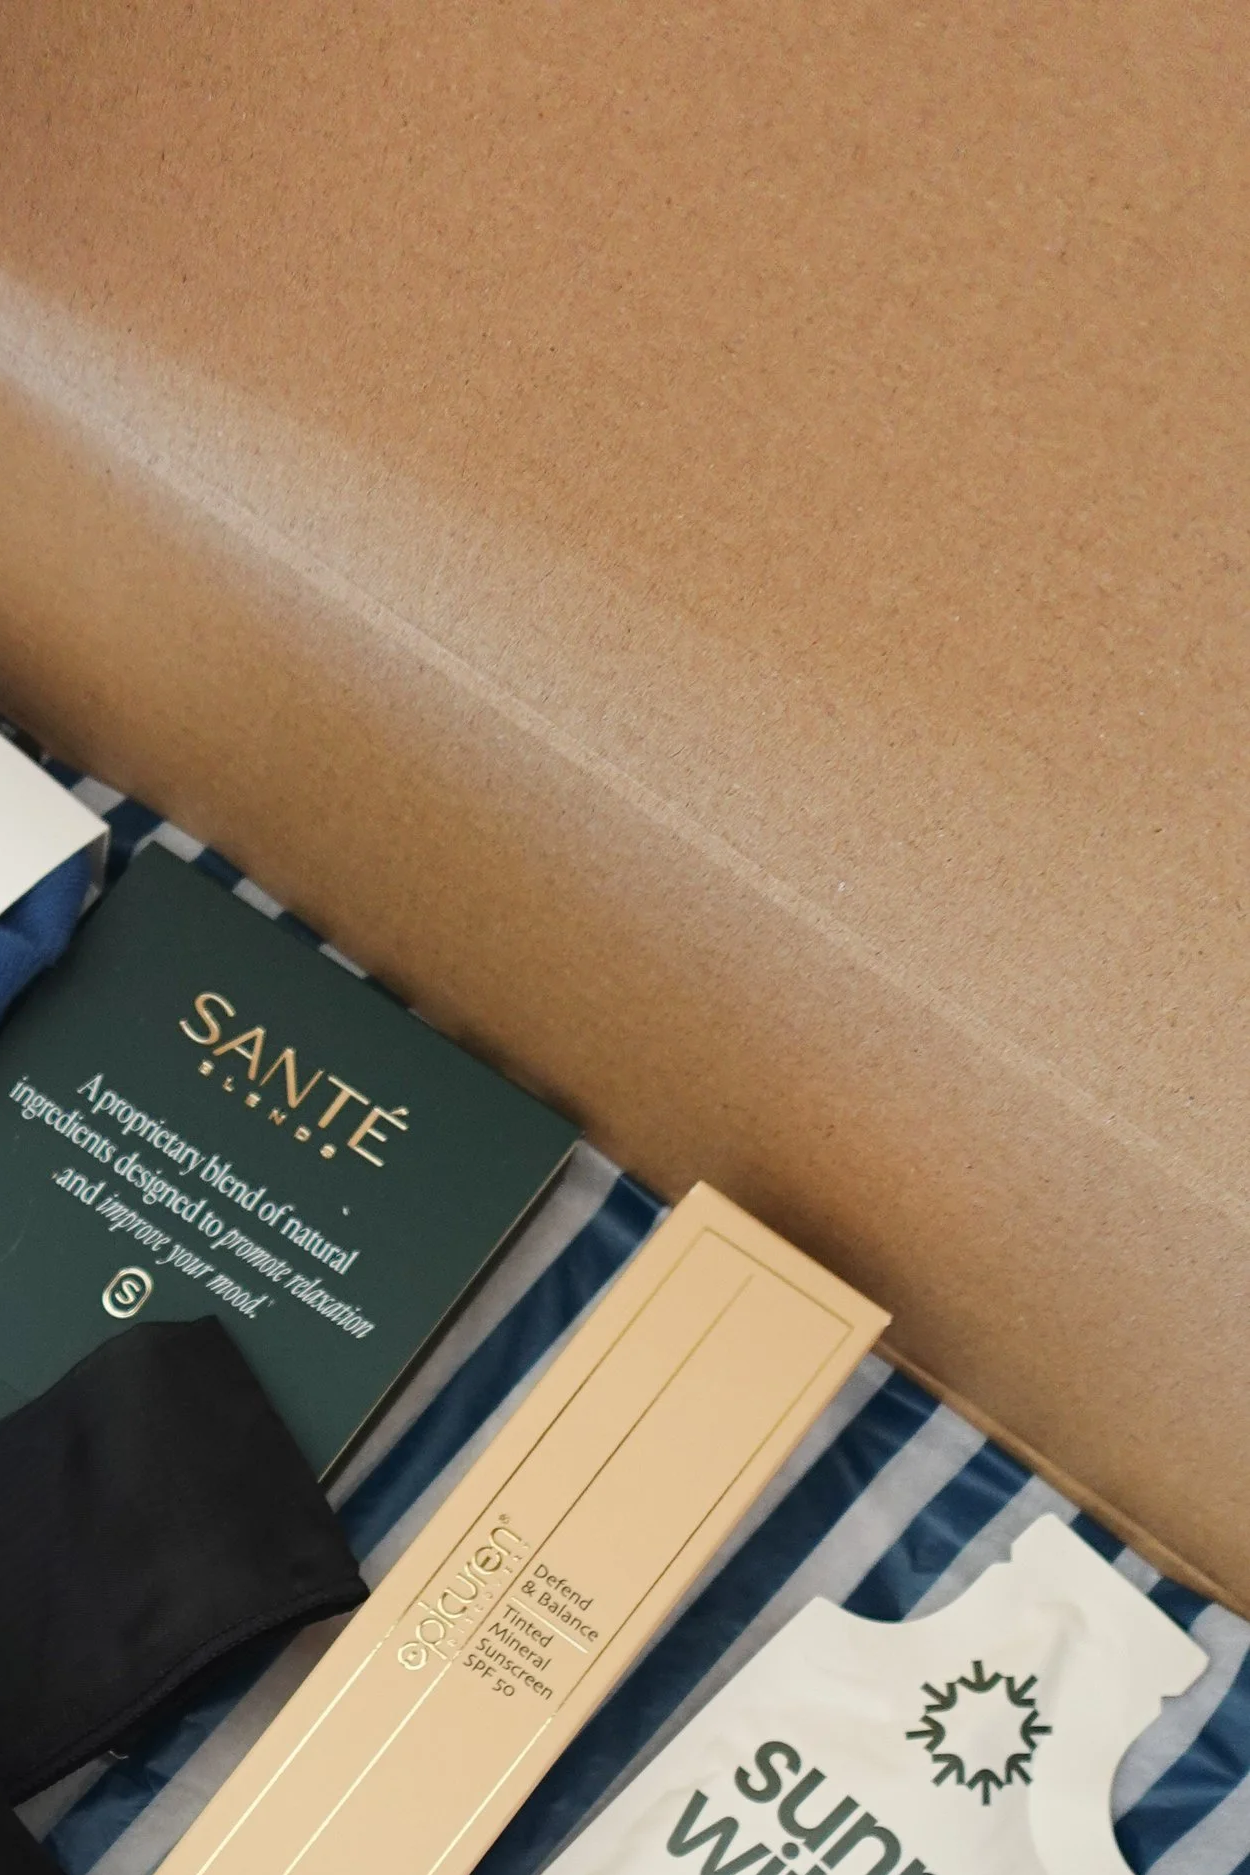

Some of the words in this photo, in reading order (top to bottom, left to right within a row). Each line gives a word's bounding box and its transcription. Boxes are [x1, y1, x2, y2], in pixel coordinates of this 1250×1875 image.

[179, 990, 411, 1168] SANTÉ
[9, 1075, 117, 1163] ingredients
[90, 1089, 206, 1176] proprietary
[200, 1154, 267, 1211] blend
[258, 1202, 294, 1227] of
[280, 1217, 360, 1275] natural
[113, 1152, 208, 1223] designed
[56, 1168, 107, 1205] and
[95, 1193, 172, 1251] improve
[155, 1244, 214, 1279] your
[198, 1211, 224, 1237] to
[210, 1227, 294, 1282] promote
[283, 1273, 376, 1339] relaxation
[520, 1580, 536, 1598] &
[537, 1592, 599, 1643] Balance
[533, 1563, 594, 1611] Defend
[488, 1622, 553, 1672] Mineral
[502, 1603, 555, 1648] Tinted
[463, 1653, 497, 1680] SPF
[492, 1677, 516, 1698] 50
[475, 1637, 554, 1701] Sunscreen
